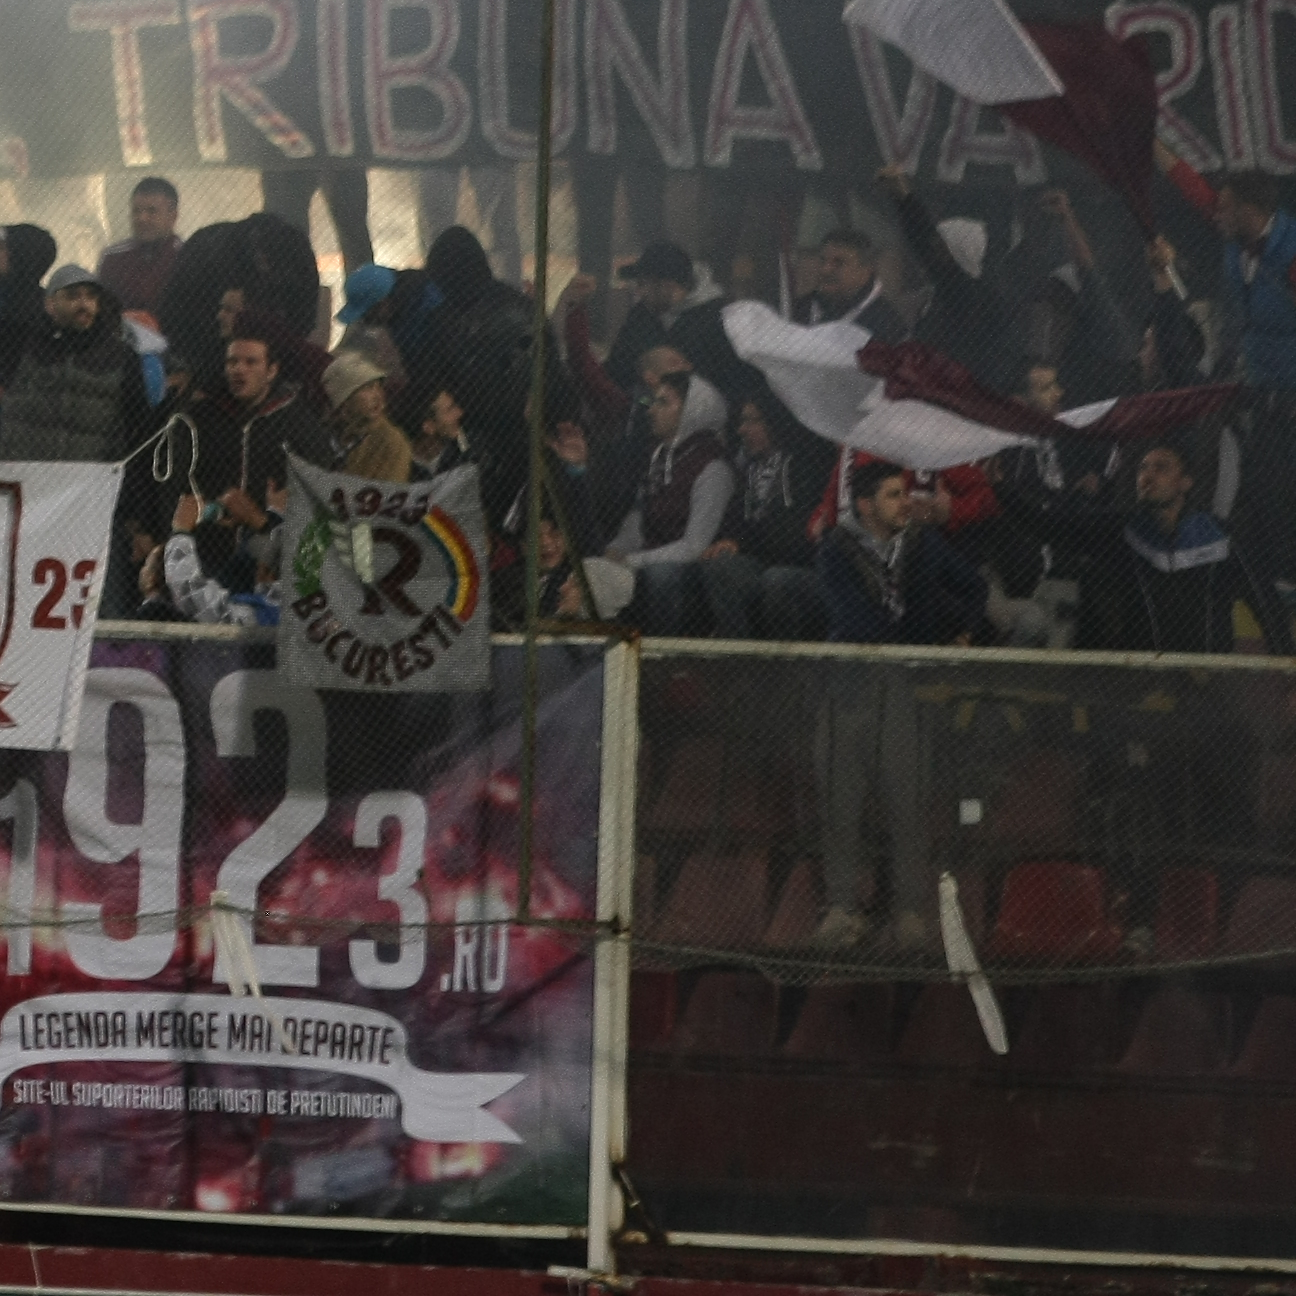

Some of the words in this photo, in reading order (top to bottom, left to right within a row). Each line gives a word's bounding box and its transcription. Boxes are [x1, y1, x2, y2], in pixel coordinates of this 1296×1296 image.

[18, 1010, 127, 1051] LEGENDA
[135, 1010, 219, 1050] MERGE
[227, 1012, 272, 1053] MAI
[281, 1016, 395, 1066] DEPARTE
[267, 1088, 289, 1116] DE
